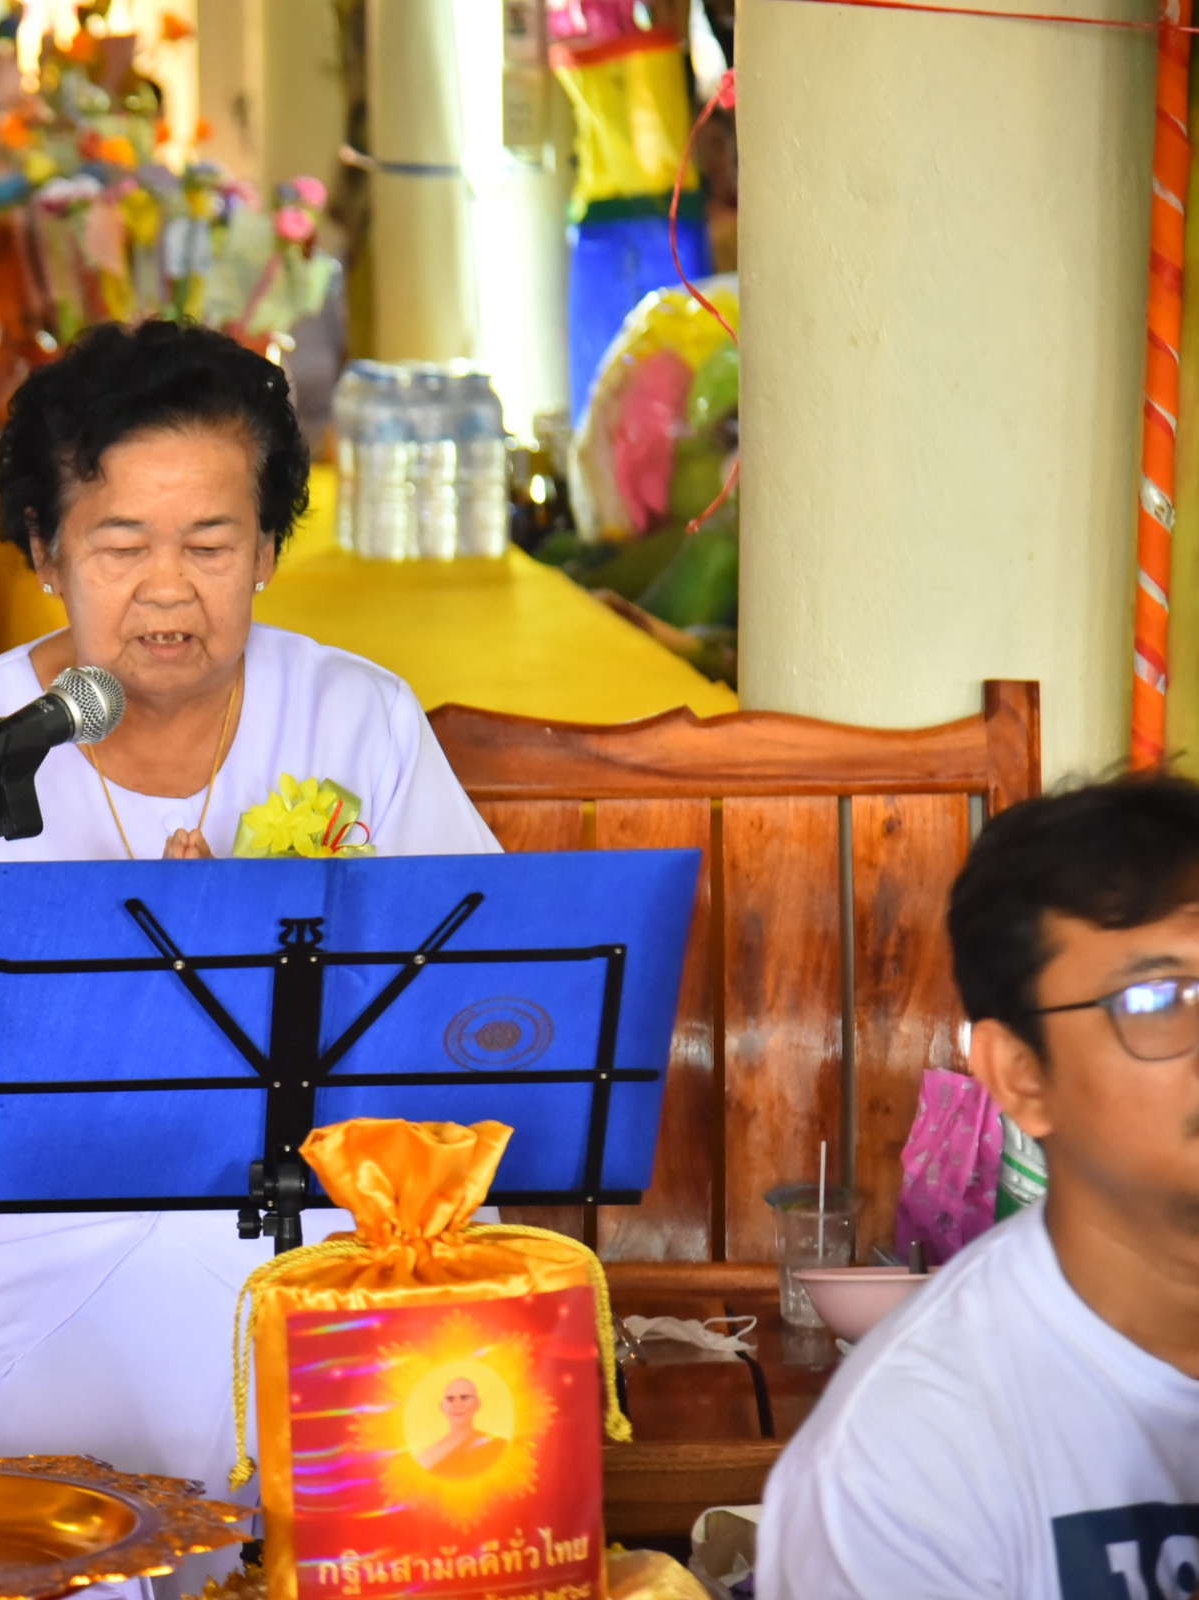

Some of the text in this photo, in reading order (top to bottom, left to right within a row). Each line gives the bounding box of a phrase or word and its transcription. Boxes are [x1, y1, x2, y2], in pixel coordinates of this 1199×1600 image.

[318, 1527, 590, 1595] กฐินสามัคคีทั่วไทย
